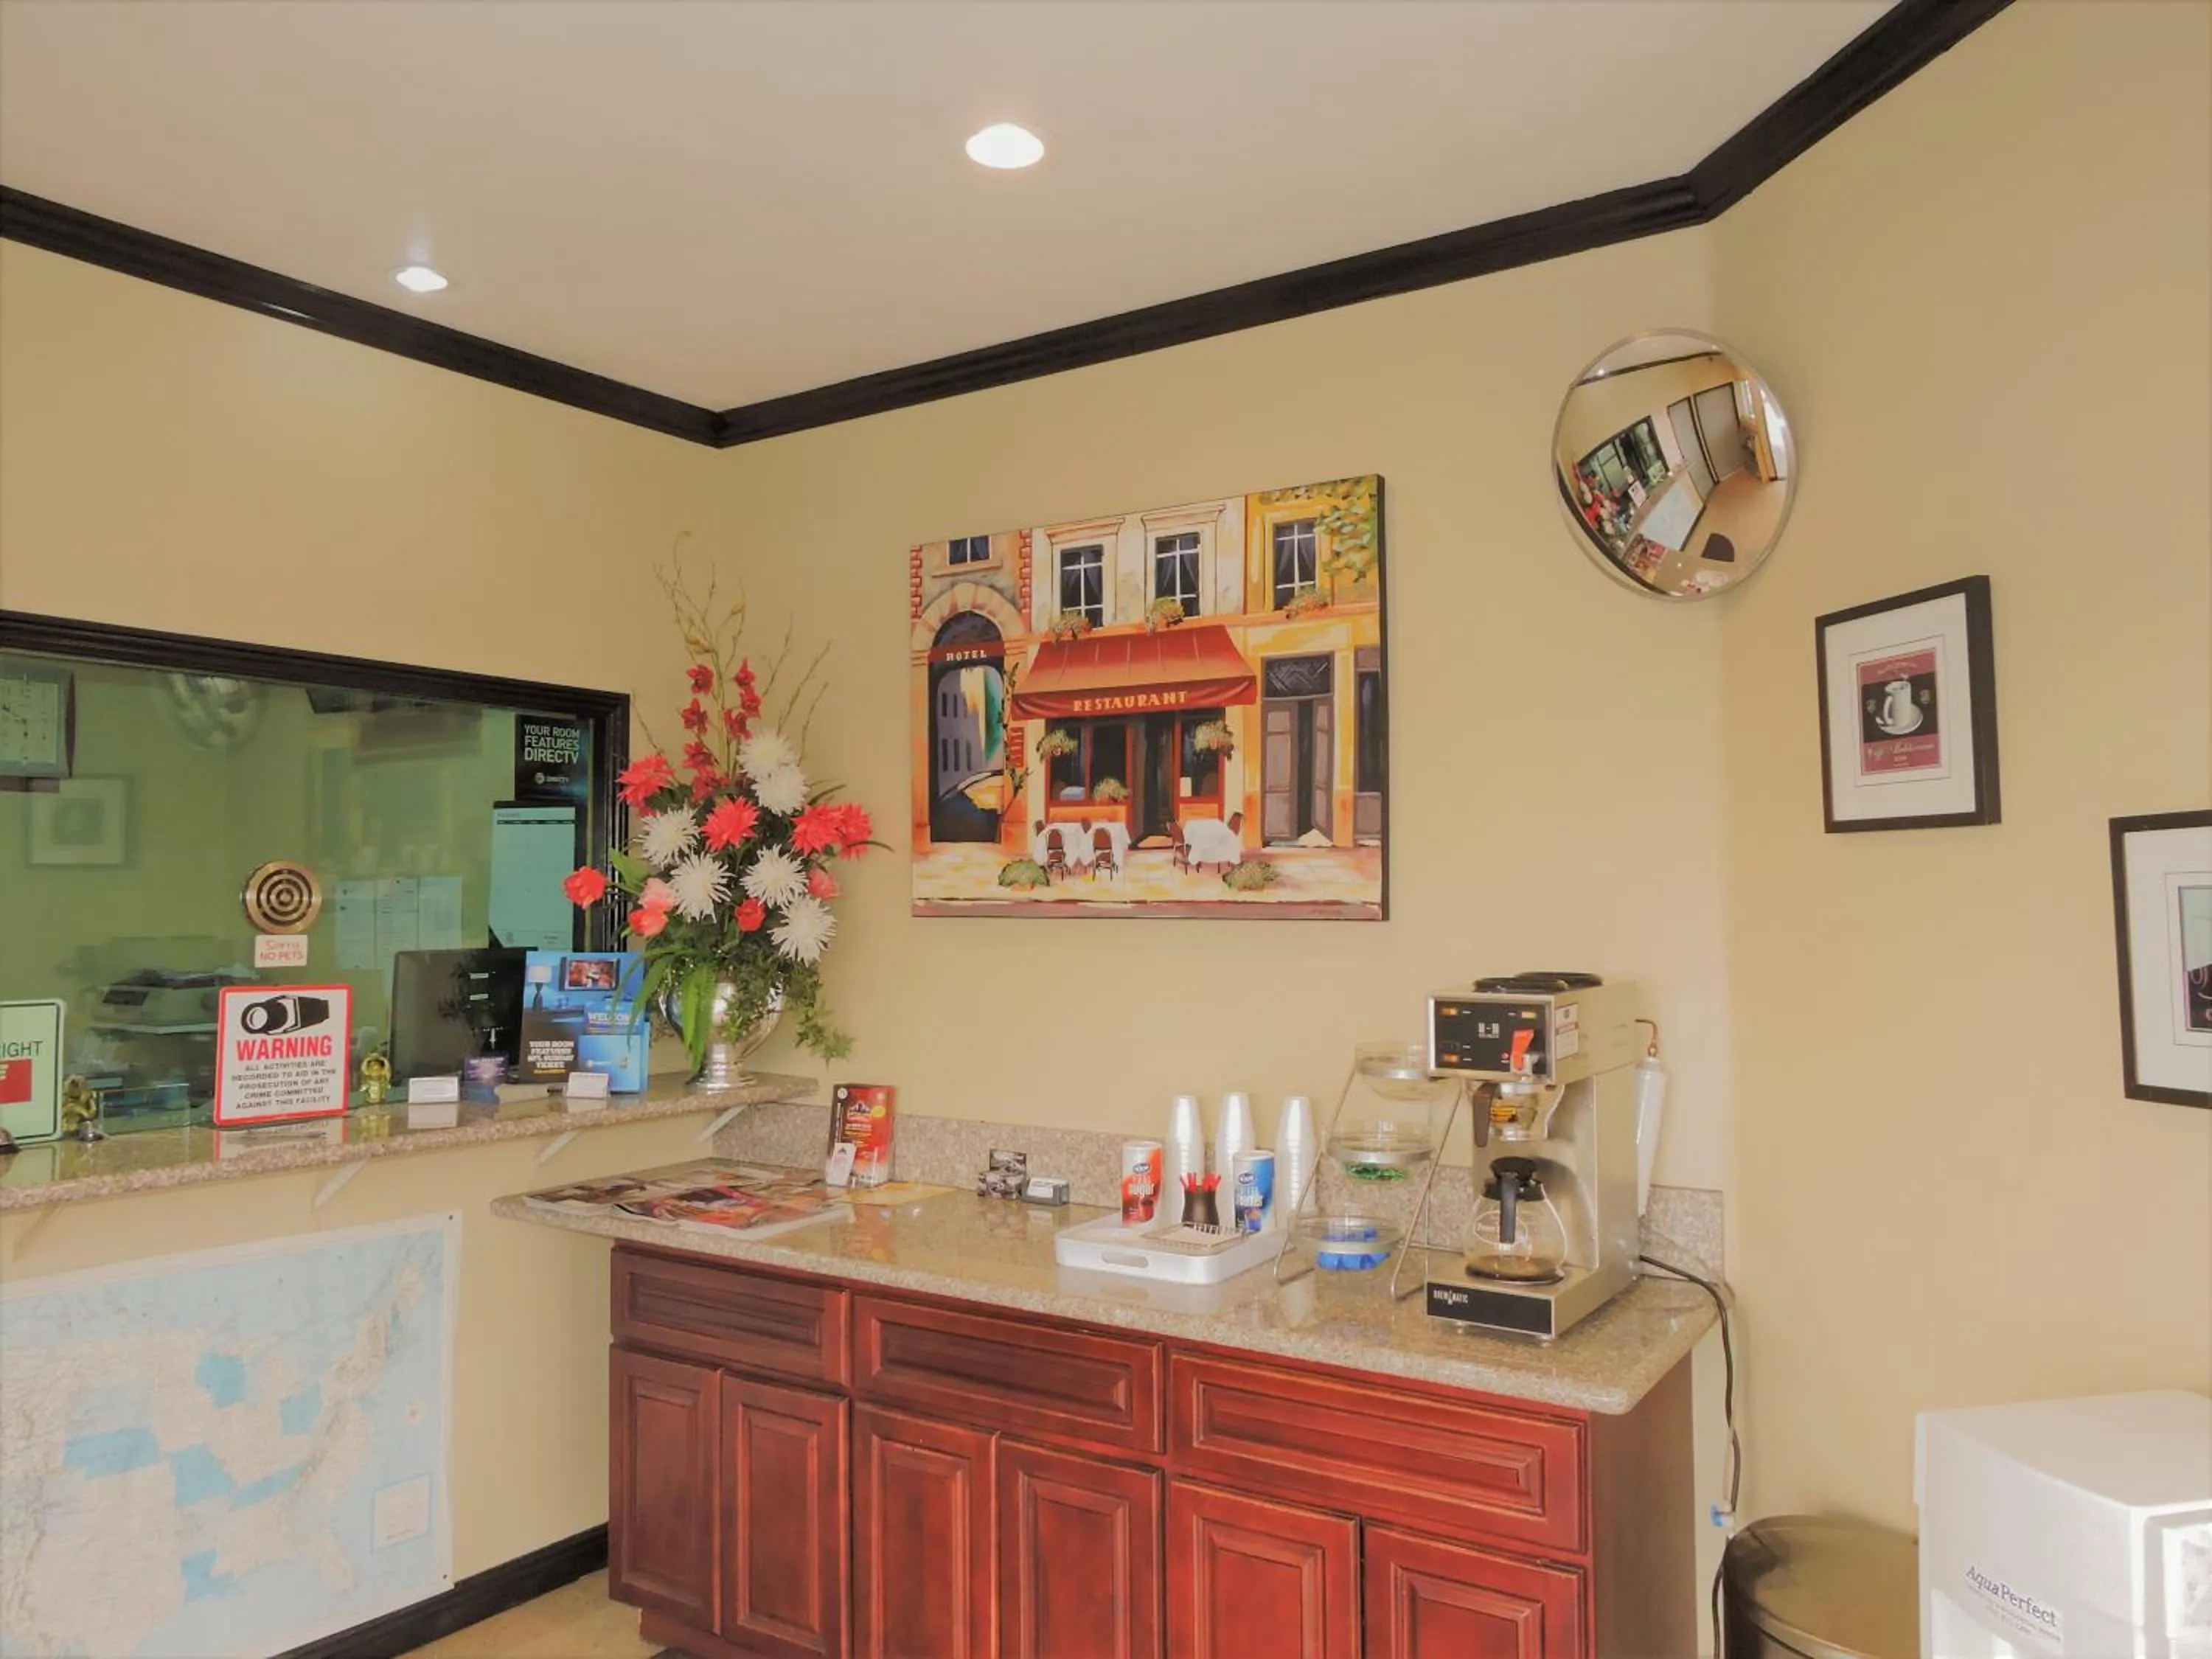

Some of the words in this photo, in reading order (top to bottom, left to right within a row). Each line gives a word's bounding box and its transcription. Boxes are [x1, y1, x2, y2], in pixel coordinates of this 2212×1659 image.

[945, 650, 987, 661] HOTEL
[1073, 691, 1188, 712] RESTAURANT
[524, 724, 551, 736] YOUR
[552, 726, 580, 739] ROOM
[524, 735, 580, 751] FEATURES
[524, 747, 579, 765] DIRECTV
[260, 951, 276, 961] NO
[279, 950, 305, 961] PETS
[588, 1012, 640, 1024] WELOM
[0, 1040, 43, 1058] IGHT
[236, 1034, 332, 1062] WARNING
[264, 1062, 307, 1070] ACTIVITIES
[232, 1072, 279, 1082] RECORDED
[238, 1081, 299, 1090] PROSECUTION
[244, 1091, 272, 1099] CRIME
[275, 1088, 324, 1097] COMMITTED
[235, 1101, 272, 1109] AGAINST
[296, 1096, 330, 1105] FACILITY
[1966, 1565, 2058, 1627] AquaPerfect
